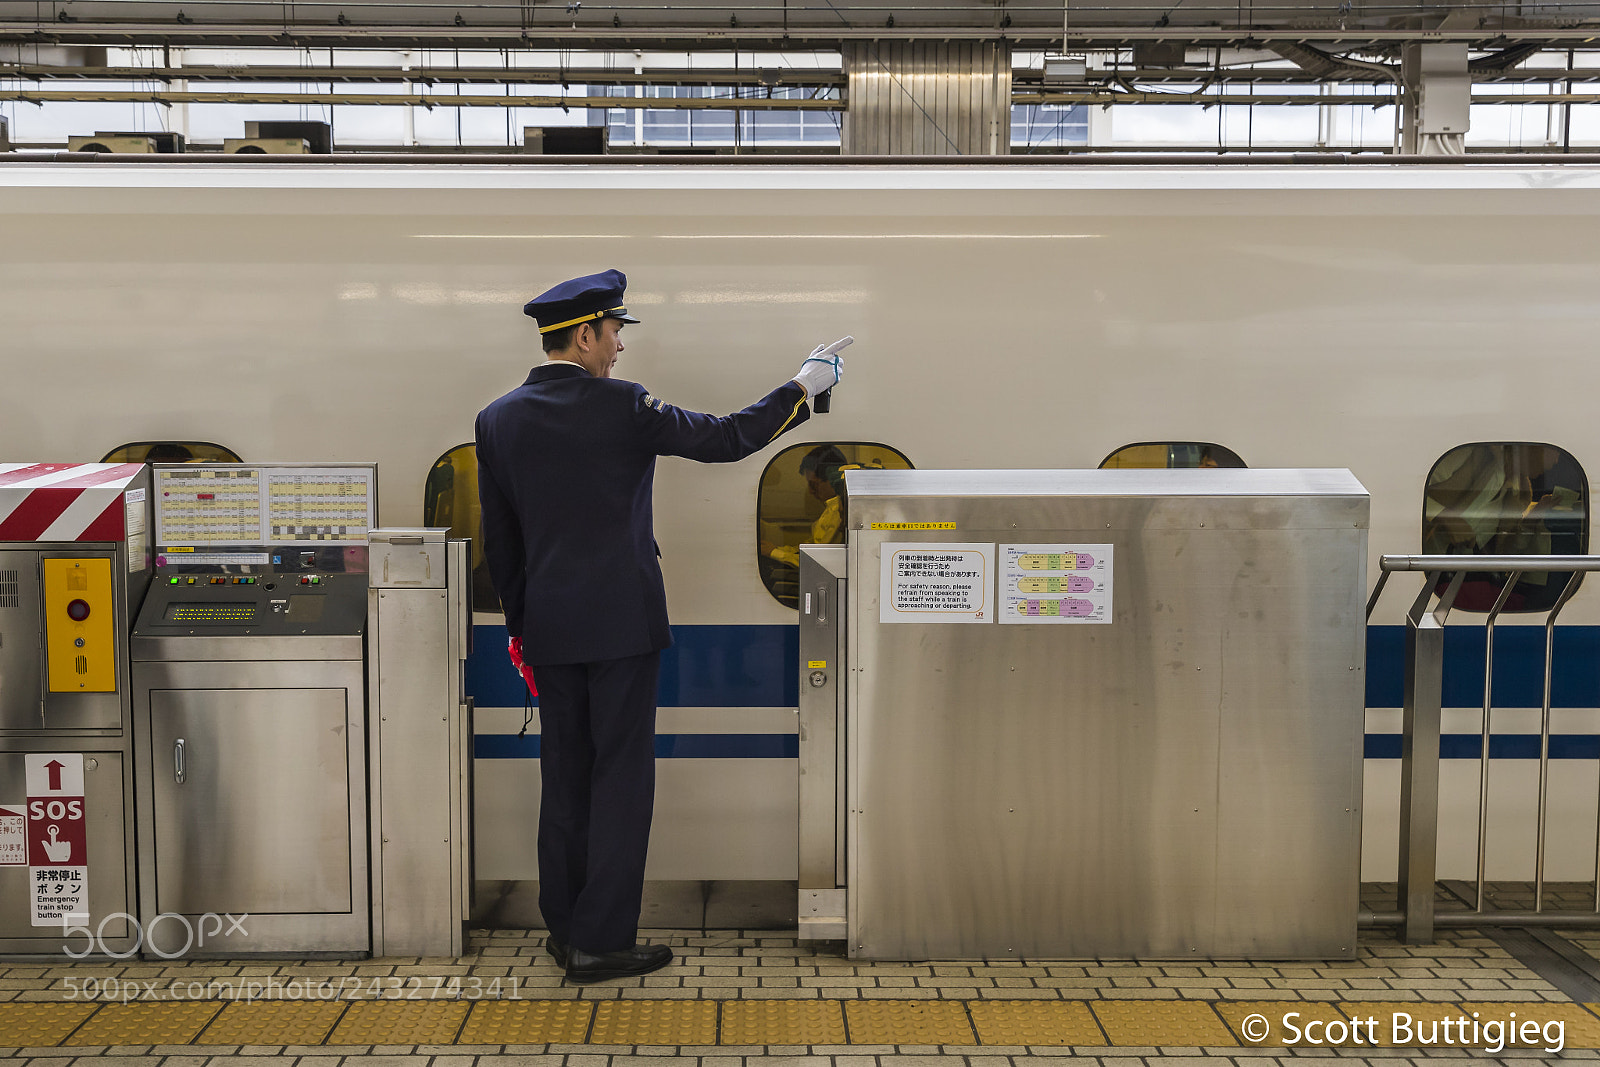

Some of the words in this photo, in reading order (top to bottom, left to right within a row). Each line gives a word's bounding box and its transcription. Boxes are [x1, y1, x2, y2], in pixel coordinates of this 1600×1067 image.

[29, 800, 83, 821] SOS
[36, 869, 82, 882] 非常停止
[37, 895, 80, 904] Emergency
[56, 904, 74, 912] stop
